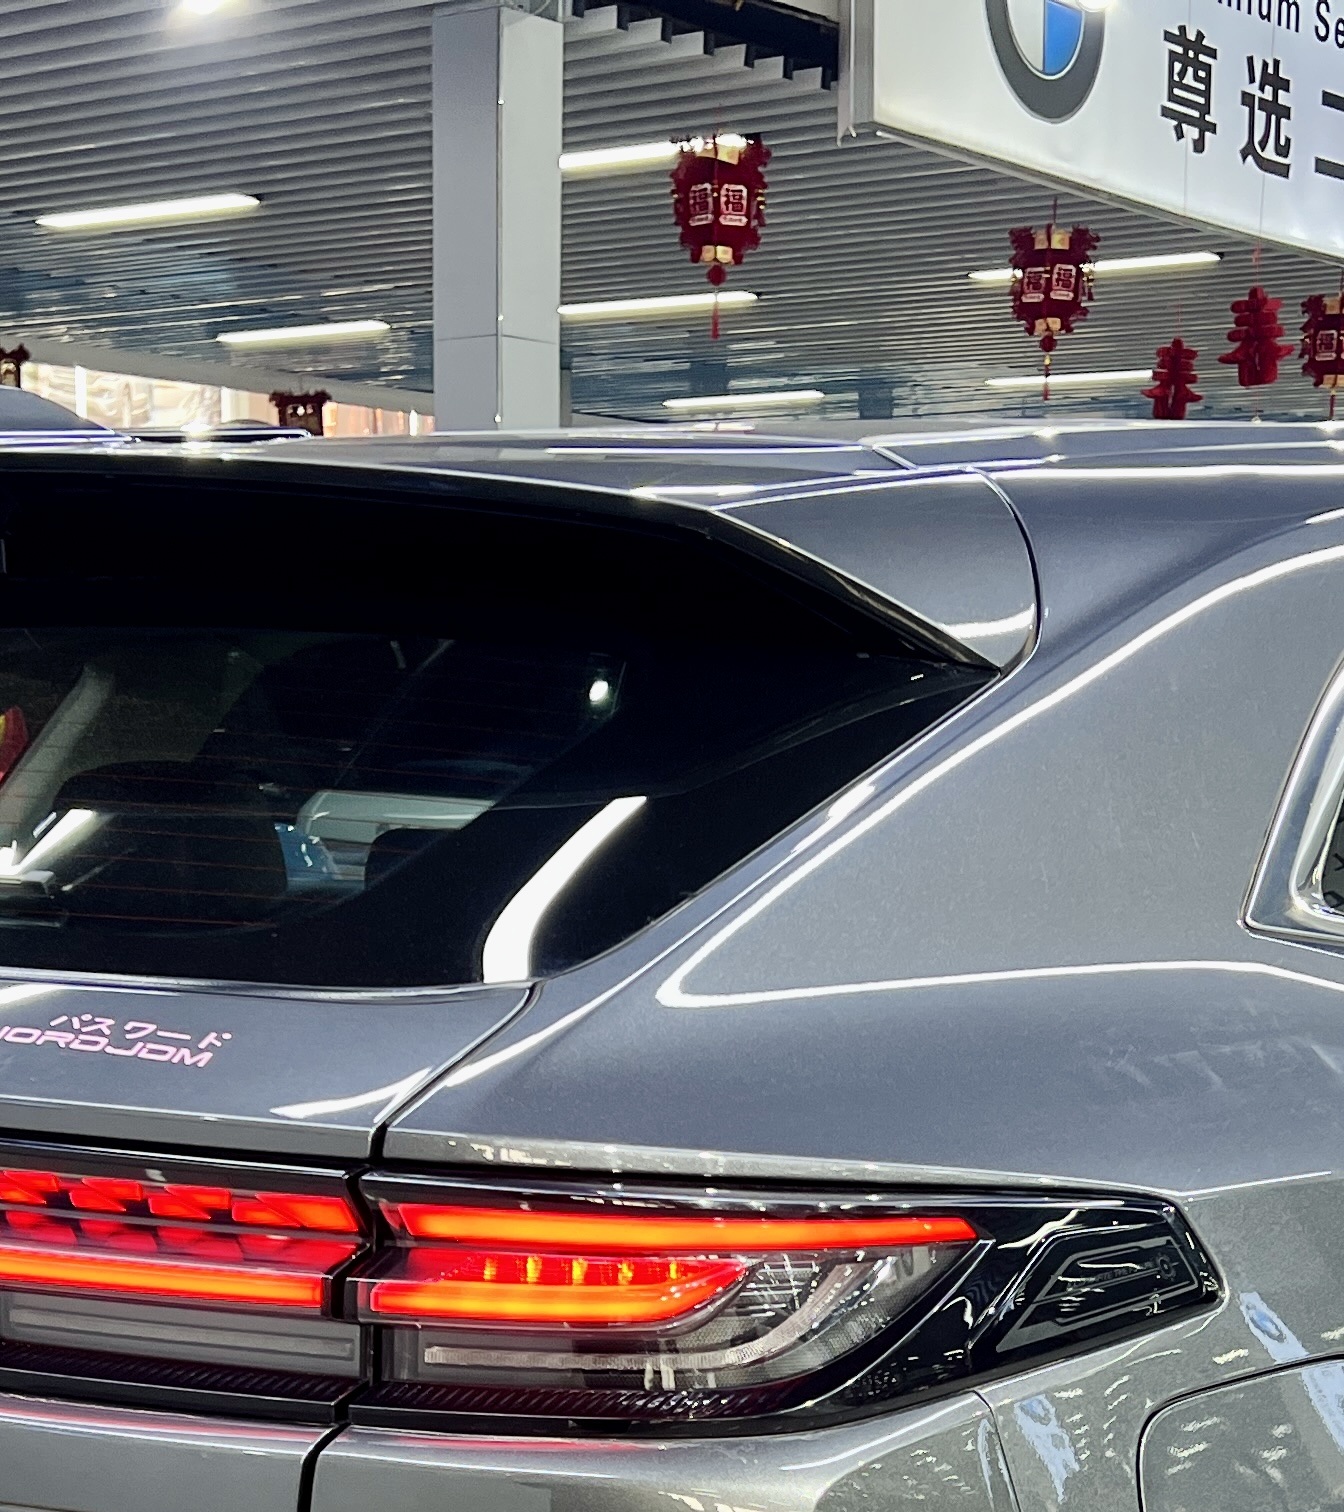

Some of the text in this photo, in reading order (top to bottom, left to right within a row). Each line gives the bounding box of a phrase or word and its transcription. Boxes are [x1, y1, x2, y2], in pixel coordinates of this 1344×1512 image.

[50, 1012, 233, 1049] パスワード
